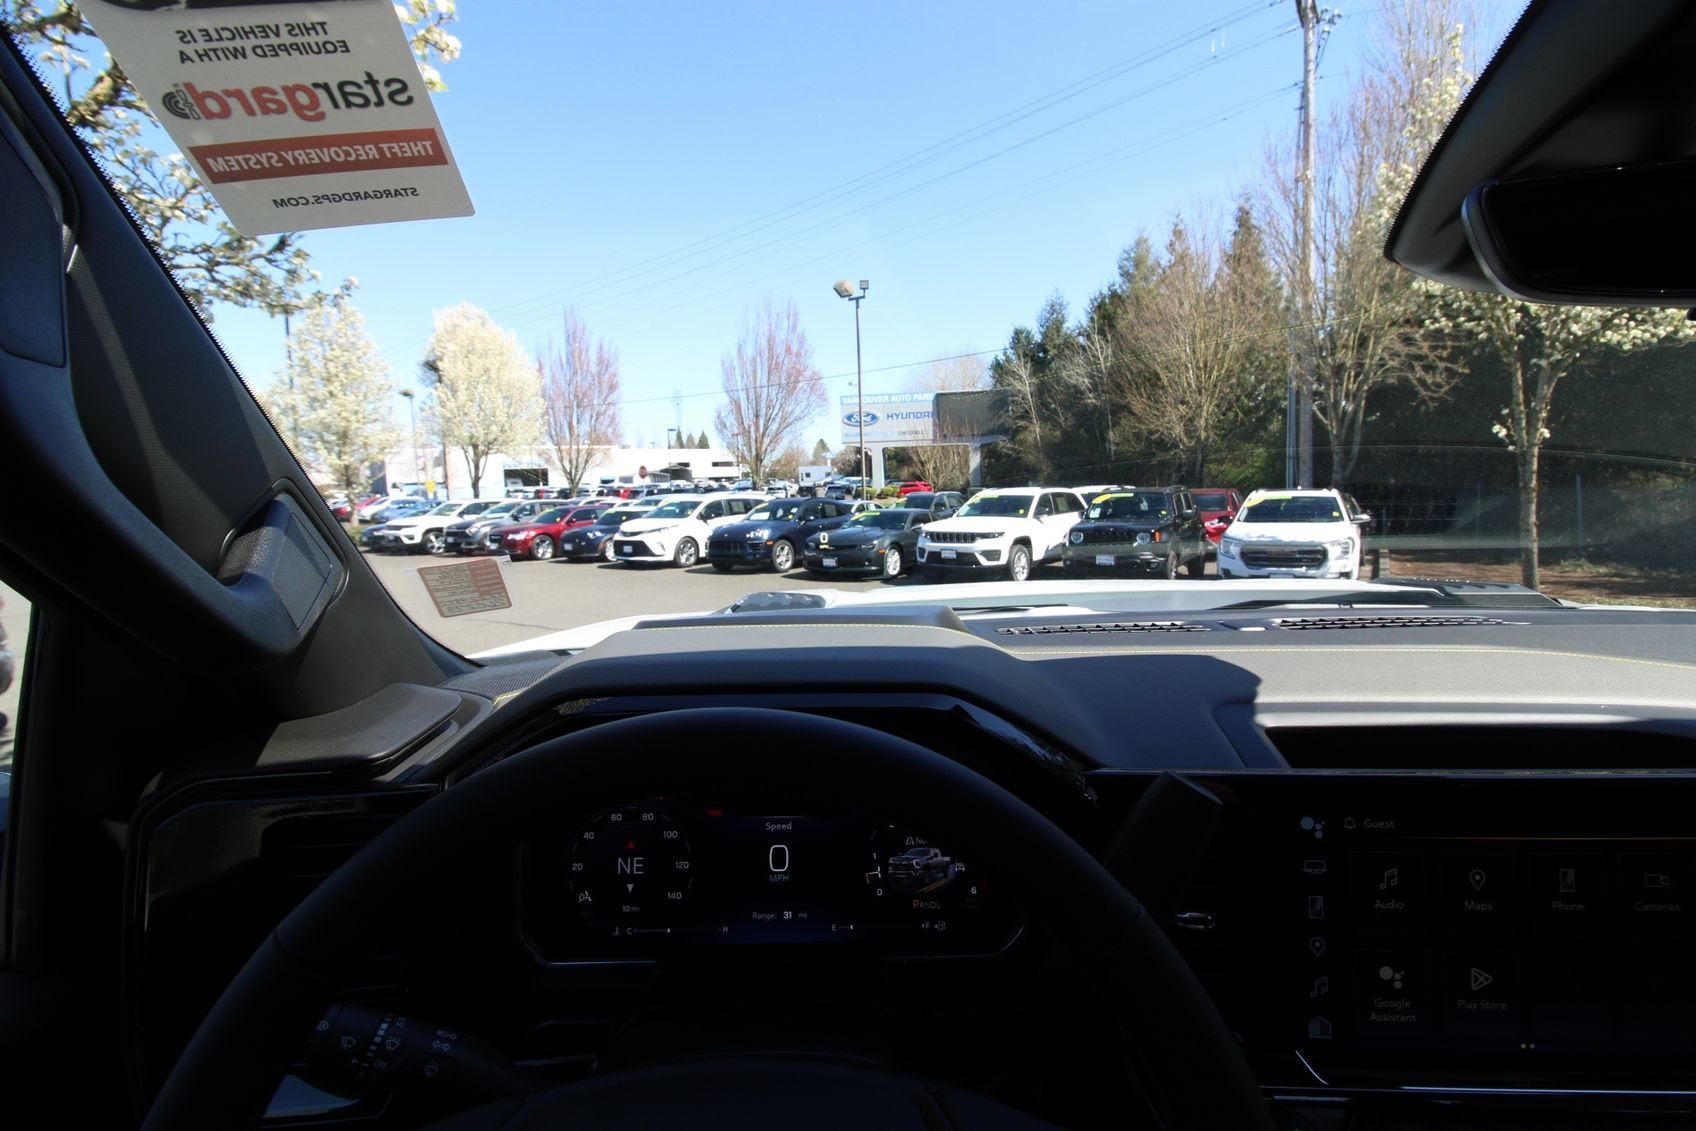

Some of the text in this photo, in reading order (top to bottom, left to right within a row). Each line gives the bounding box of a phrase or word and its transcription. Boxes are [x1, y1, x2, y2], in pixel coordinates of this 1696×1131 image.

[842, 395, 889, 404] VANOUVER
[891, 394, 912, 402] AUTO
[610, 813, 622, 822] 60
[642, 813, 654, 821] 80
[765, 821, 792, 831] Speed
[1363, 818, 1395, 830] Guest
[583, 831, 595, 840] 40
[663, 830, 678, 839] 100
[768, 844, 789, 872] 0
[572, 863, 583, 871] 20
[617, 856, 645, 875] NE
[675, 861, 690, 870] 120
[769, 874, 789, 882] MPH
[667, 891, 682, 900] 140
[1374, 899, 1404, 911] Audio
[1464, 900, 1493, 913] Maps
[1552, 900, 1584, 911] Phone
[1634, 901, 1681, 912] Cameras
[752, 912, 777, 921] Range:
[783, 911, 792, 919] 31
[1374, 998, 1411, 1012] Google
[1457, 999, 1507, 1012] Play Store
[1369, 1012, 1416, 1024] Assistant
